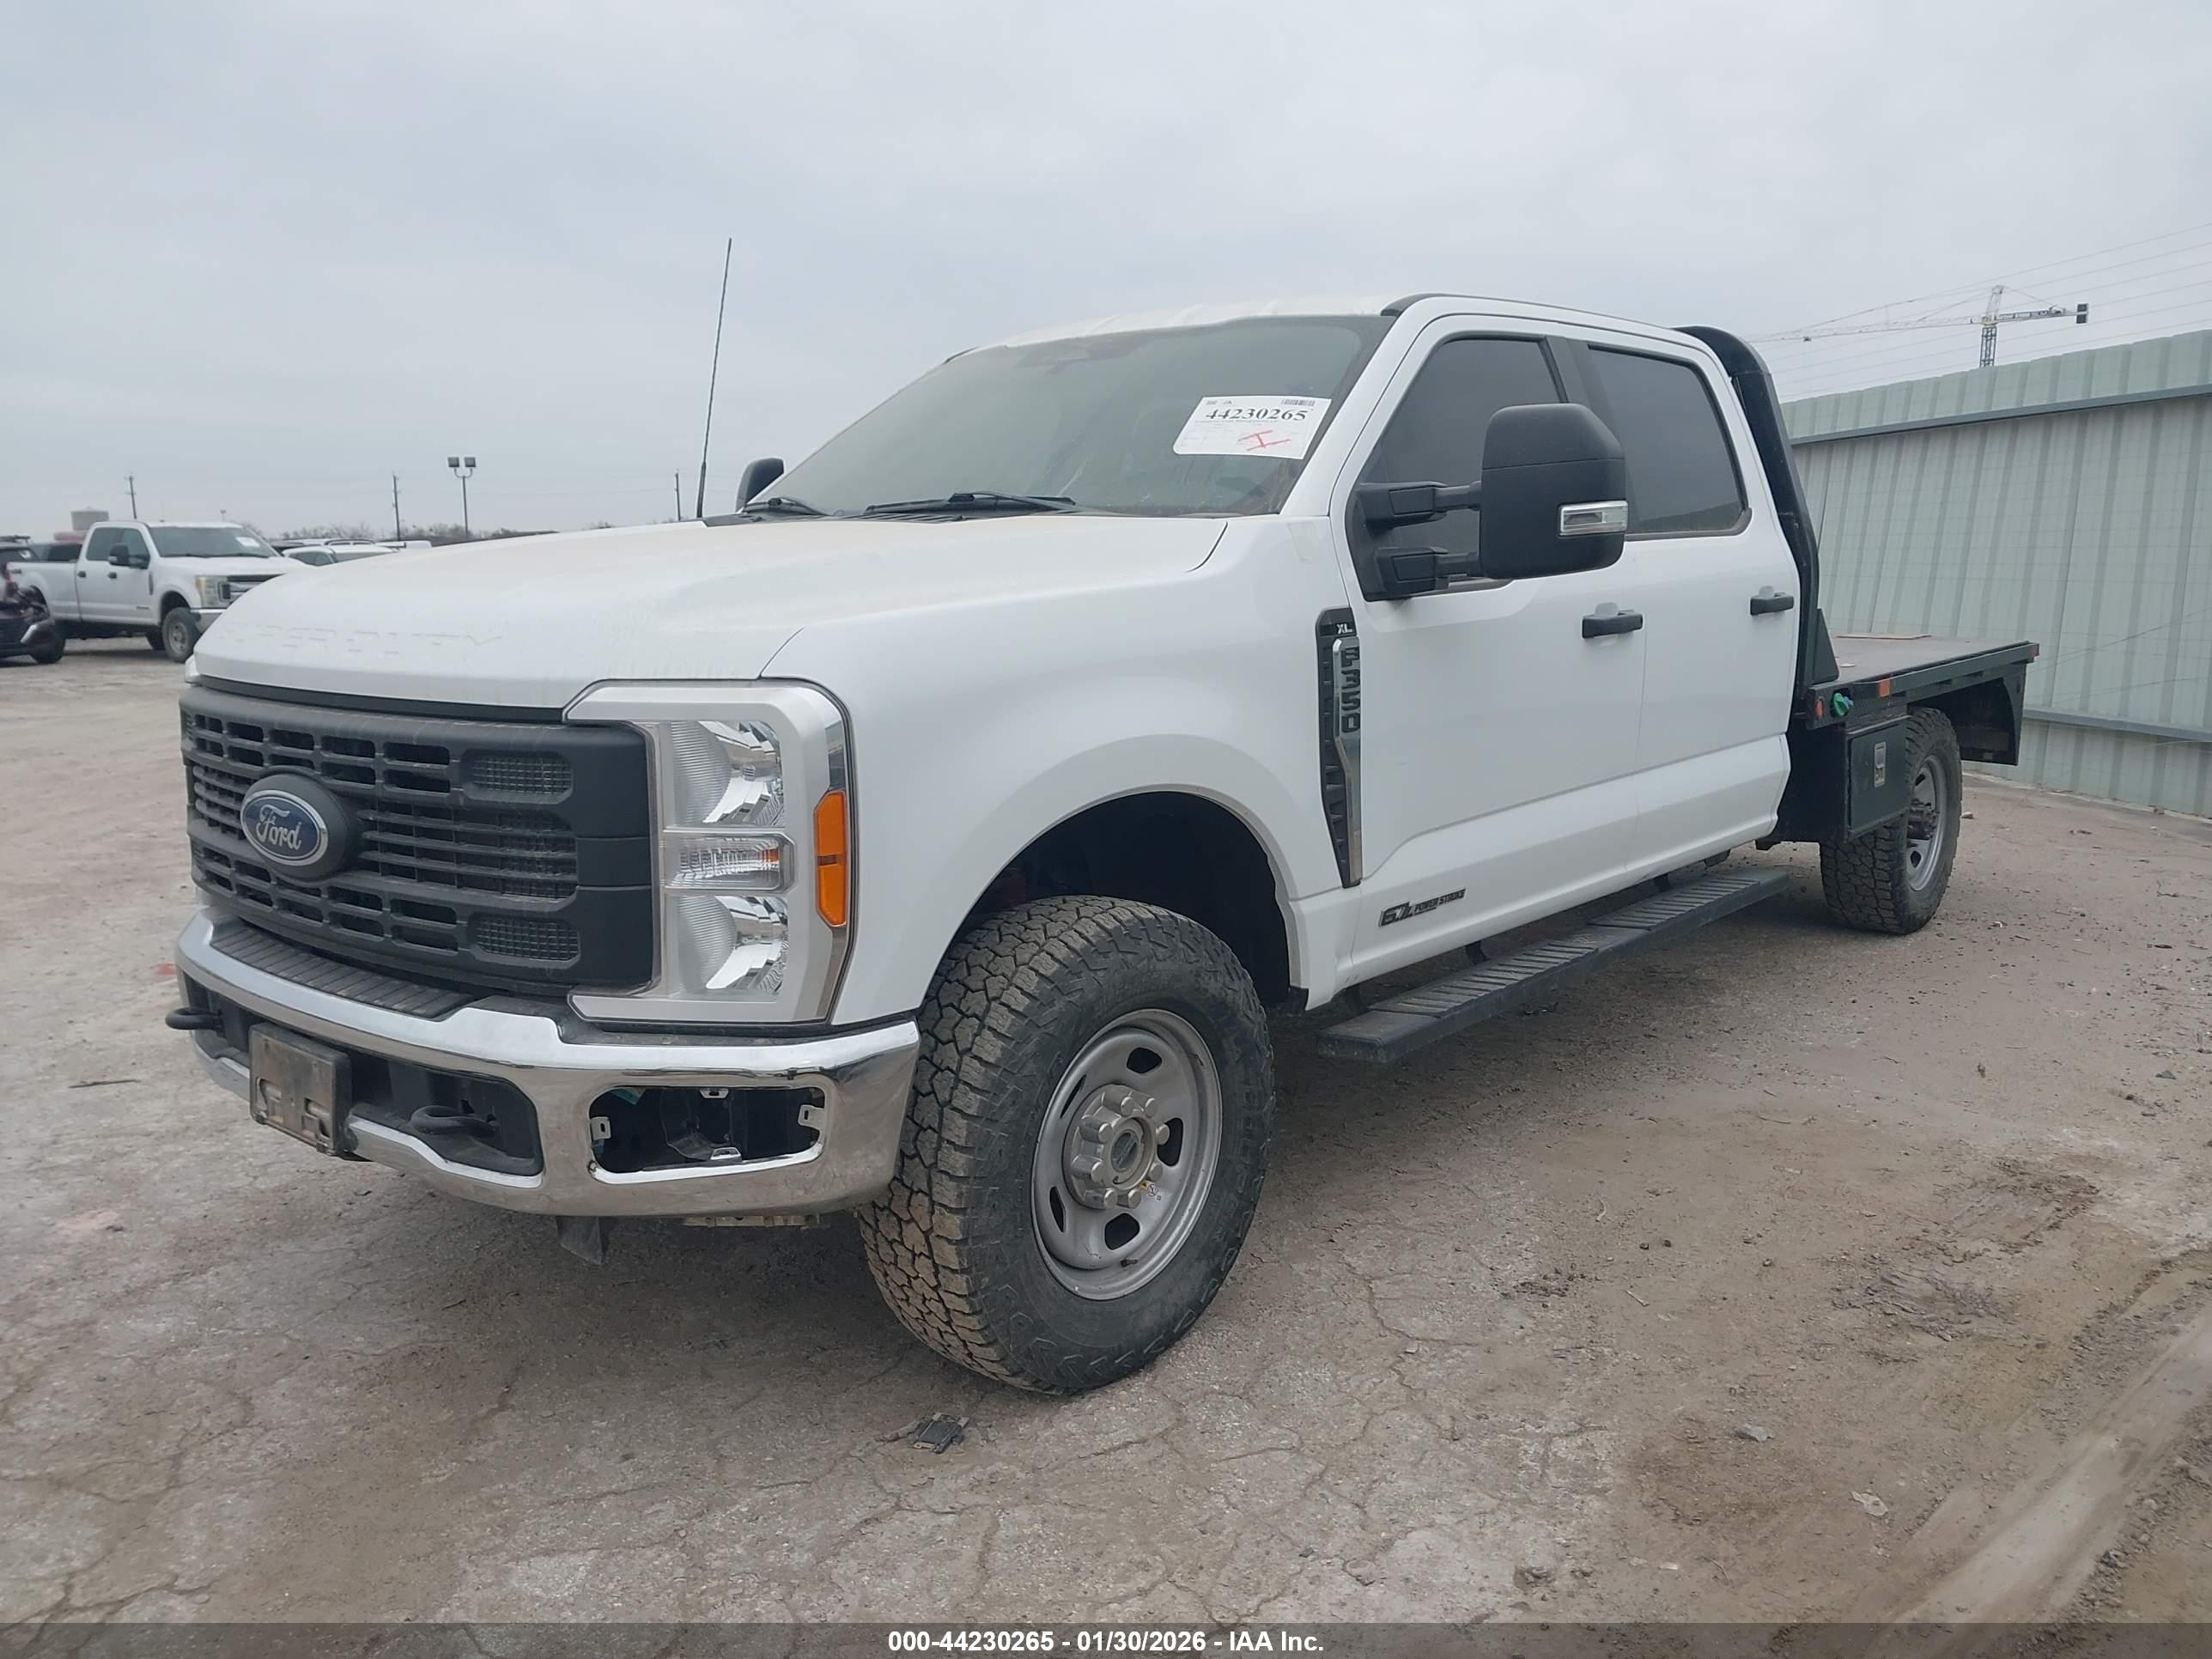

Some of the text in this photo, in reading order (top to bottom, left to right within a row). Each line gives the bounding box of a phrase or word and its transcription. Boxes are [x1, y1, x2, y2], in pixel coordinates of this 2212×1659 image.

[1205, 408, 1309, 421] 44230265
[1336, 623, 1353, 634] XL
[256, 804, 302, 850] Ford
